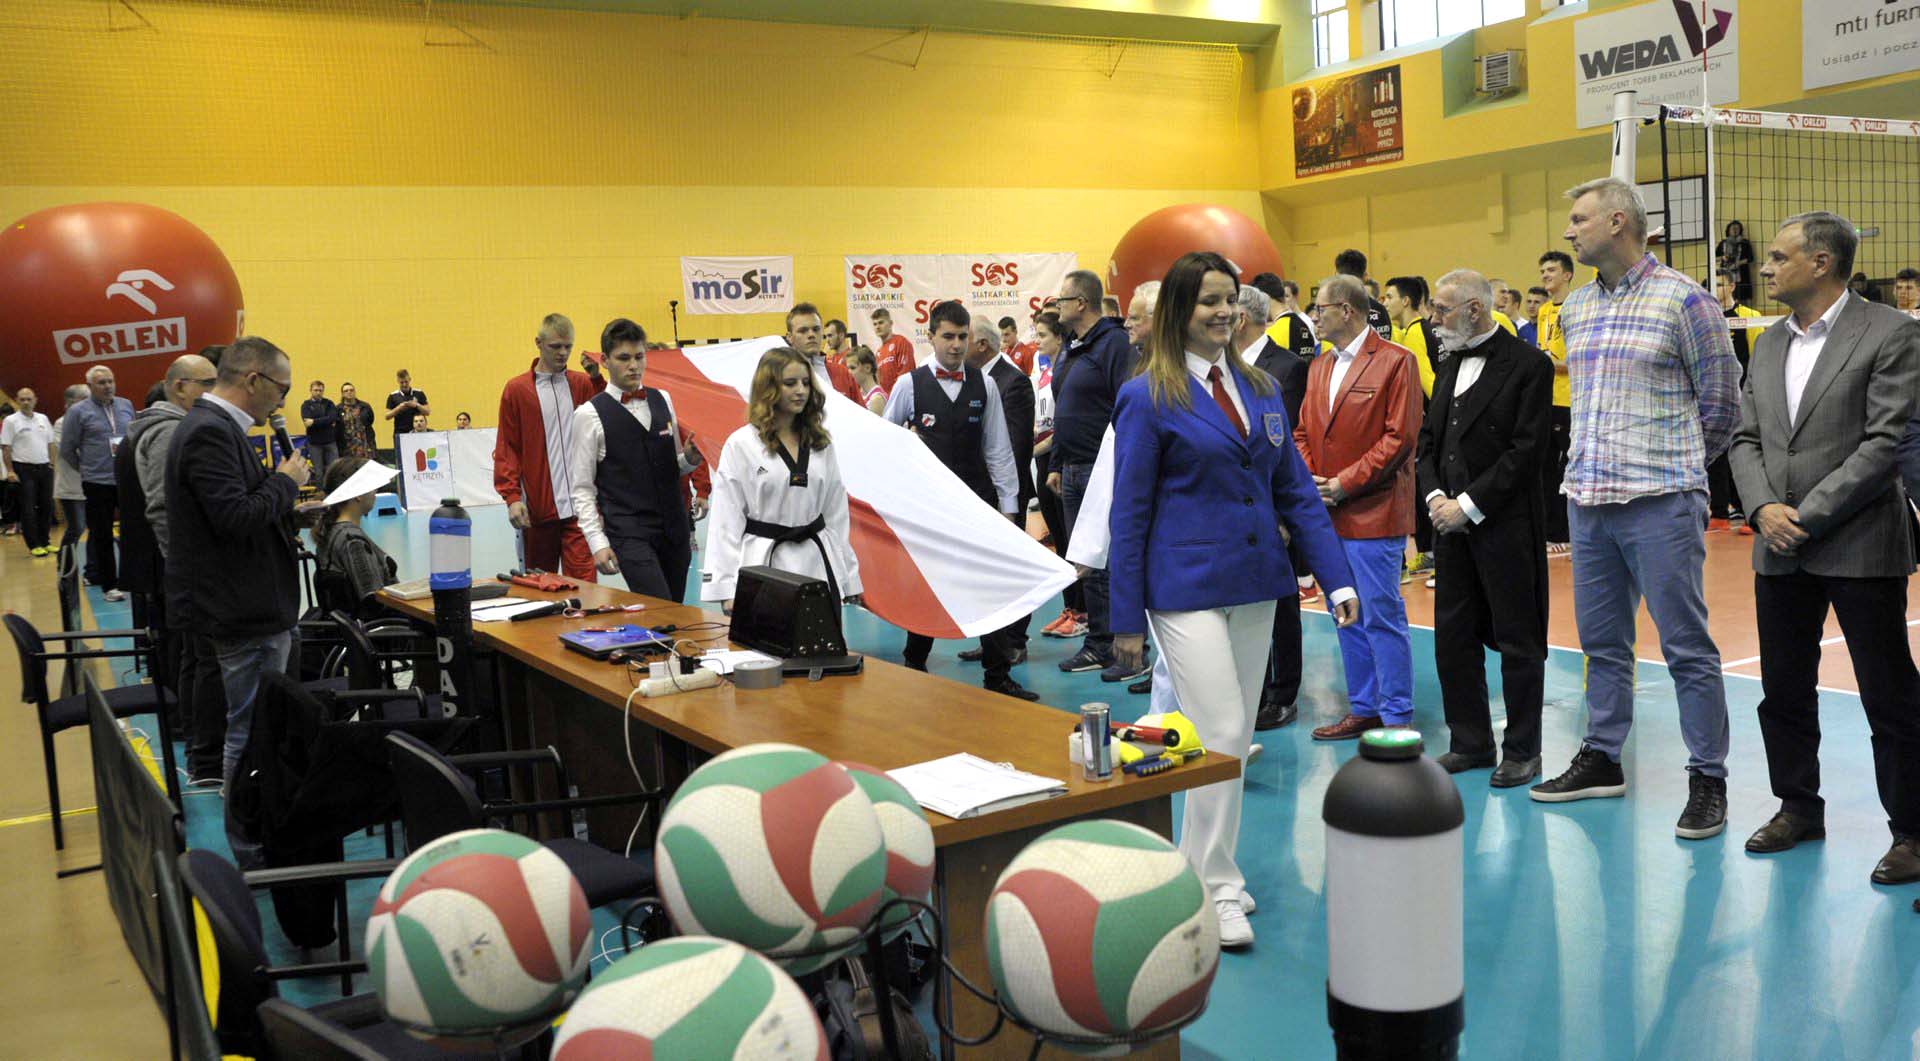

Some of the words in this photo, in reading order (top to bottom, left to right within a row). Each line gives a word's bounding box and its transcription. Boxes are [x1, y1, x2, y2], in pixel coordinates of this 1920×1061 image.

[1835, 16, 1868, 36] mti
[1579, 34, 1681, 80] WEDA
[1586, 79, 1631, 95] PRODUCENT
[1632, 72, 1657, 86] TOREB
[1659, 62, 1721, 80] REKLAMOWCH
[851, 264, 903, 288] SOS
[971, 262, 1019, 286] SOS
[852, 293, 904, 302] SIATKARSKIE
[972, 290, 1019, 299] SIATKARSKIE
[63, 323, 179, 358] ORLEN
